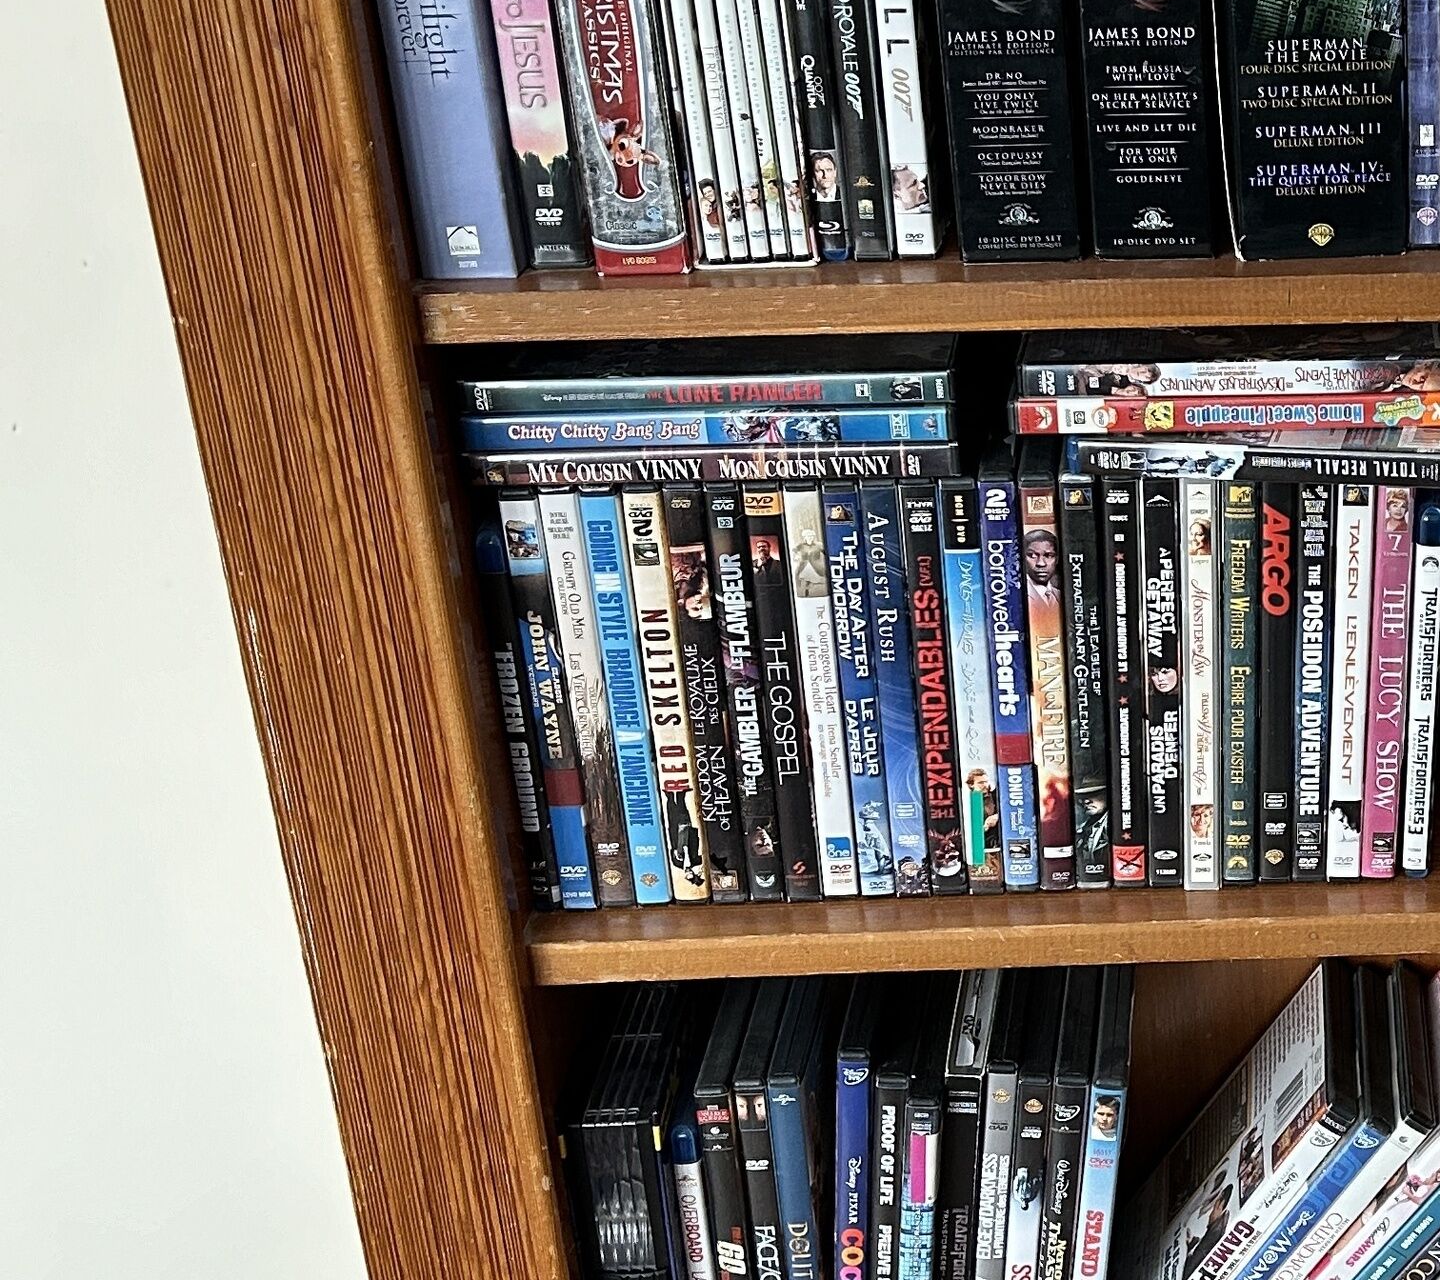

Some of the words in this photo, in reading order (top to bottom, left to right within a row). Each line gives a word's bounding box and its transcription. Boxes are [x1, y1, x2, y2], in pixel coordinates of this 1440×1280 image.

[948, 29, 999, 45] JAMES
[1006, 29, 1056, 43] BOND
[1088, 27, 1138, 41] JAMES
[1145, 26, 1196, 40] BOND
[1267, 39, 1365, 52] SUPERMAN
[500, 15, 548, 110] JESUS
[1265, 50, 1299, 62] THE
[1309, 48, 1367, 61] MOVIE
[1258, 86, 1353, 98] SUPERMAN
[1361, 85, 1376, 95] II
[972, 124, 1045, 135] MOONRAKER
[1255, 126, 1350, 138] SUPERMAN
[1360, 125, 1382, 135] III
[977, 152, 1044, 161] OCTOPUSSY
[1116, 174, 1182, 183] GOLDENEYE
[508, 424, 557, 443] Chitty
[560, 421, 610, 441] Chitty
[611, 420, 655, 442] Bang
[657, 418, 702, 439] Bang
[527, 462, 559, 485] MY
[562, 462, 635, 483] COUSIN
[638, 461, 702, 482] VINNY
[718, 458, 759, 479] MON
[765, 457, 826, 478] COUSIN
[828, 455, 890, 477] VINNY
[1314, 458, 1368, 477] RECALL
[1372, 459, 1418, 479] TOTAL
[866, 511, 890, 601] AUGUST
[1261, 502, 1292, 617] ARGO
[1346, 520, 1361, 599] TAKEN
[1381, 586, 1407, 639] THE
[876, 607, 899, 664] RUSH
[640, 608, 682, 727] SKELTON
[913, 588, 955, 806] EXPENDABLES
[1377, 656, 1405, 728] LUCY
[659, 745, 692, 793] RED
[1374, 740, 1401, 814] SHOW
